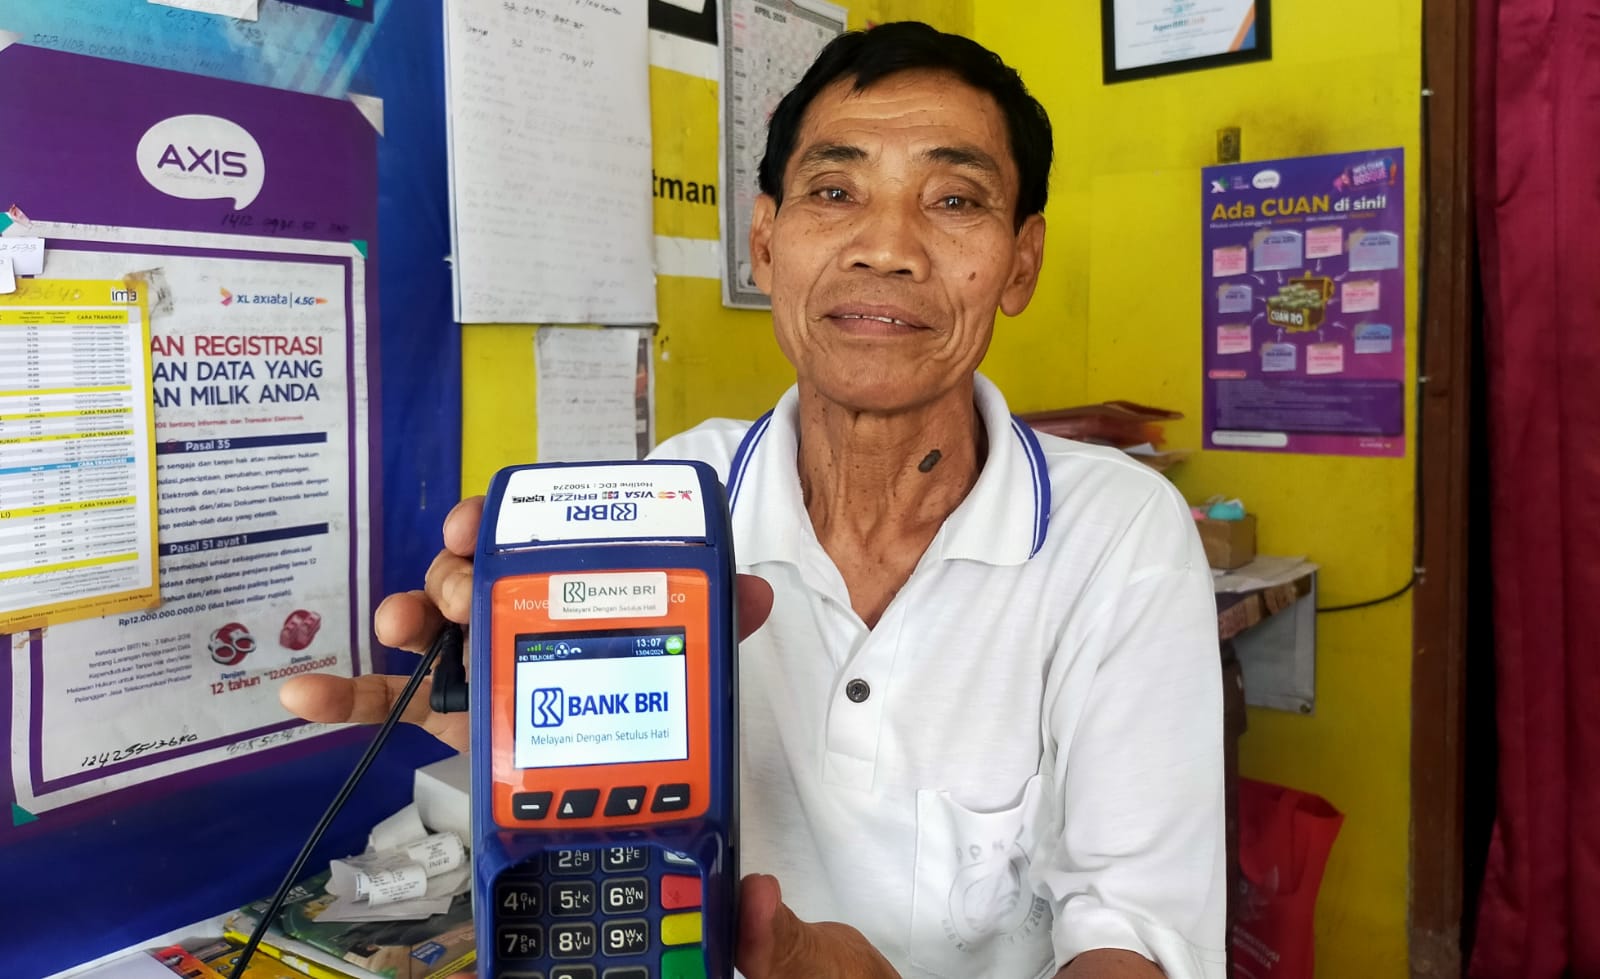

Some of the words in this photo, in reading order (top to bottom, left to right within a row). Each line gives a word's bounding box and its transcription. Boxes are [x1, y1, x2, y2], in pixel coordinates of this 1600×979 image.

[157, 144, 247, 178] AXIS
[653, 169, 716, 206] tman
[1211, 201, 1256, 221] Ada
[1261, 195, 1330, 217] CUAN
[1334, 199, 1349, 212] di
[1353, 194, 1387, 211] sini!
[236, 294, 250, 304] XL
[253, 293, 288, 305] axiata
[294, 296, 316, 306] 4.5G
[194, 336, 323, 356] REGISTRASI
[197, 361, 255, 381] DATA
[265, 360, 323, 379] YANG
[191, 385, 250, 406] MILIK
[258, 383, 320, 404] ANDA
[185, 441, 215, 452] Pasal
[217, 439, 231, 451] 35
[167, 463, 196, 471] sengaja
[161, 488, 200, 500] Elektronik
[202, 486, 235, 496] dan/atau
[236, 484, 270, 493] Dokumen
[620, 482, 653, 490] Hotline
[551, 493, 598, 501] BRIZZI
[625, 491, 655, 499] VISA
[159, 504, 197, 515] Elektronik
[199, 502, 233, 511] dan/atau
[234, 498, 267, 508] Dokumen
[566, 505, 608, 521] BRI
[217, 515, 233, 524] data
[169, 544, 200, 555] Pasal
[201, 539, 214, 551] 51
[217, 537, 240, 550] ayat
[242, 535, 249, 545] 1
[185, 575, 214, 587] dengan
[187, 588, 222, 601] dan/atau
[588, 586, 629, 597] BANK
[633, 585, 656, 595] BRI
[514, 598, 549, 611] Move
[593, 605, 617, 613] Dengan
[636, 638, 661, 648] 13:07
[210, 682, 224, 695] 12
[228, 676, 261, 691] tahun
[568, 693, 630, 716] BANK
[635, 691, 668, 713] BRI
[531, 734, 574, 746] Melayani
[576, 732, 612, 744] Dengan
[615, 731, 648, 741] Setulus
[651, 729, 669, 739] Hati
[558, 850, 572, 867] 2
[610, 847, 624, 864] 3
[504, 892, 518, 910] 4
[560, 890, 574, 908] 5
[609, 887, 624, 906] 6
[505, 934, 518, 952] 7
[559, 932, 573, 951] 8
[610, 929, 625, 948] 9
